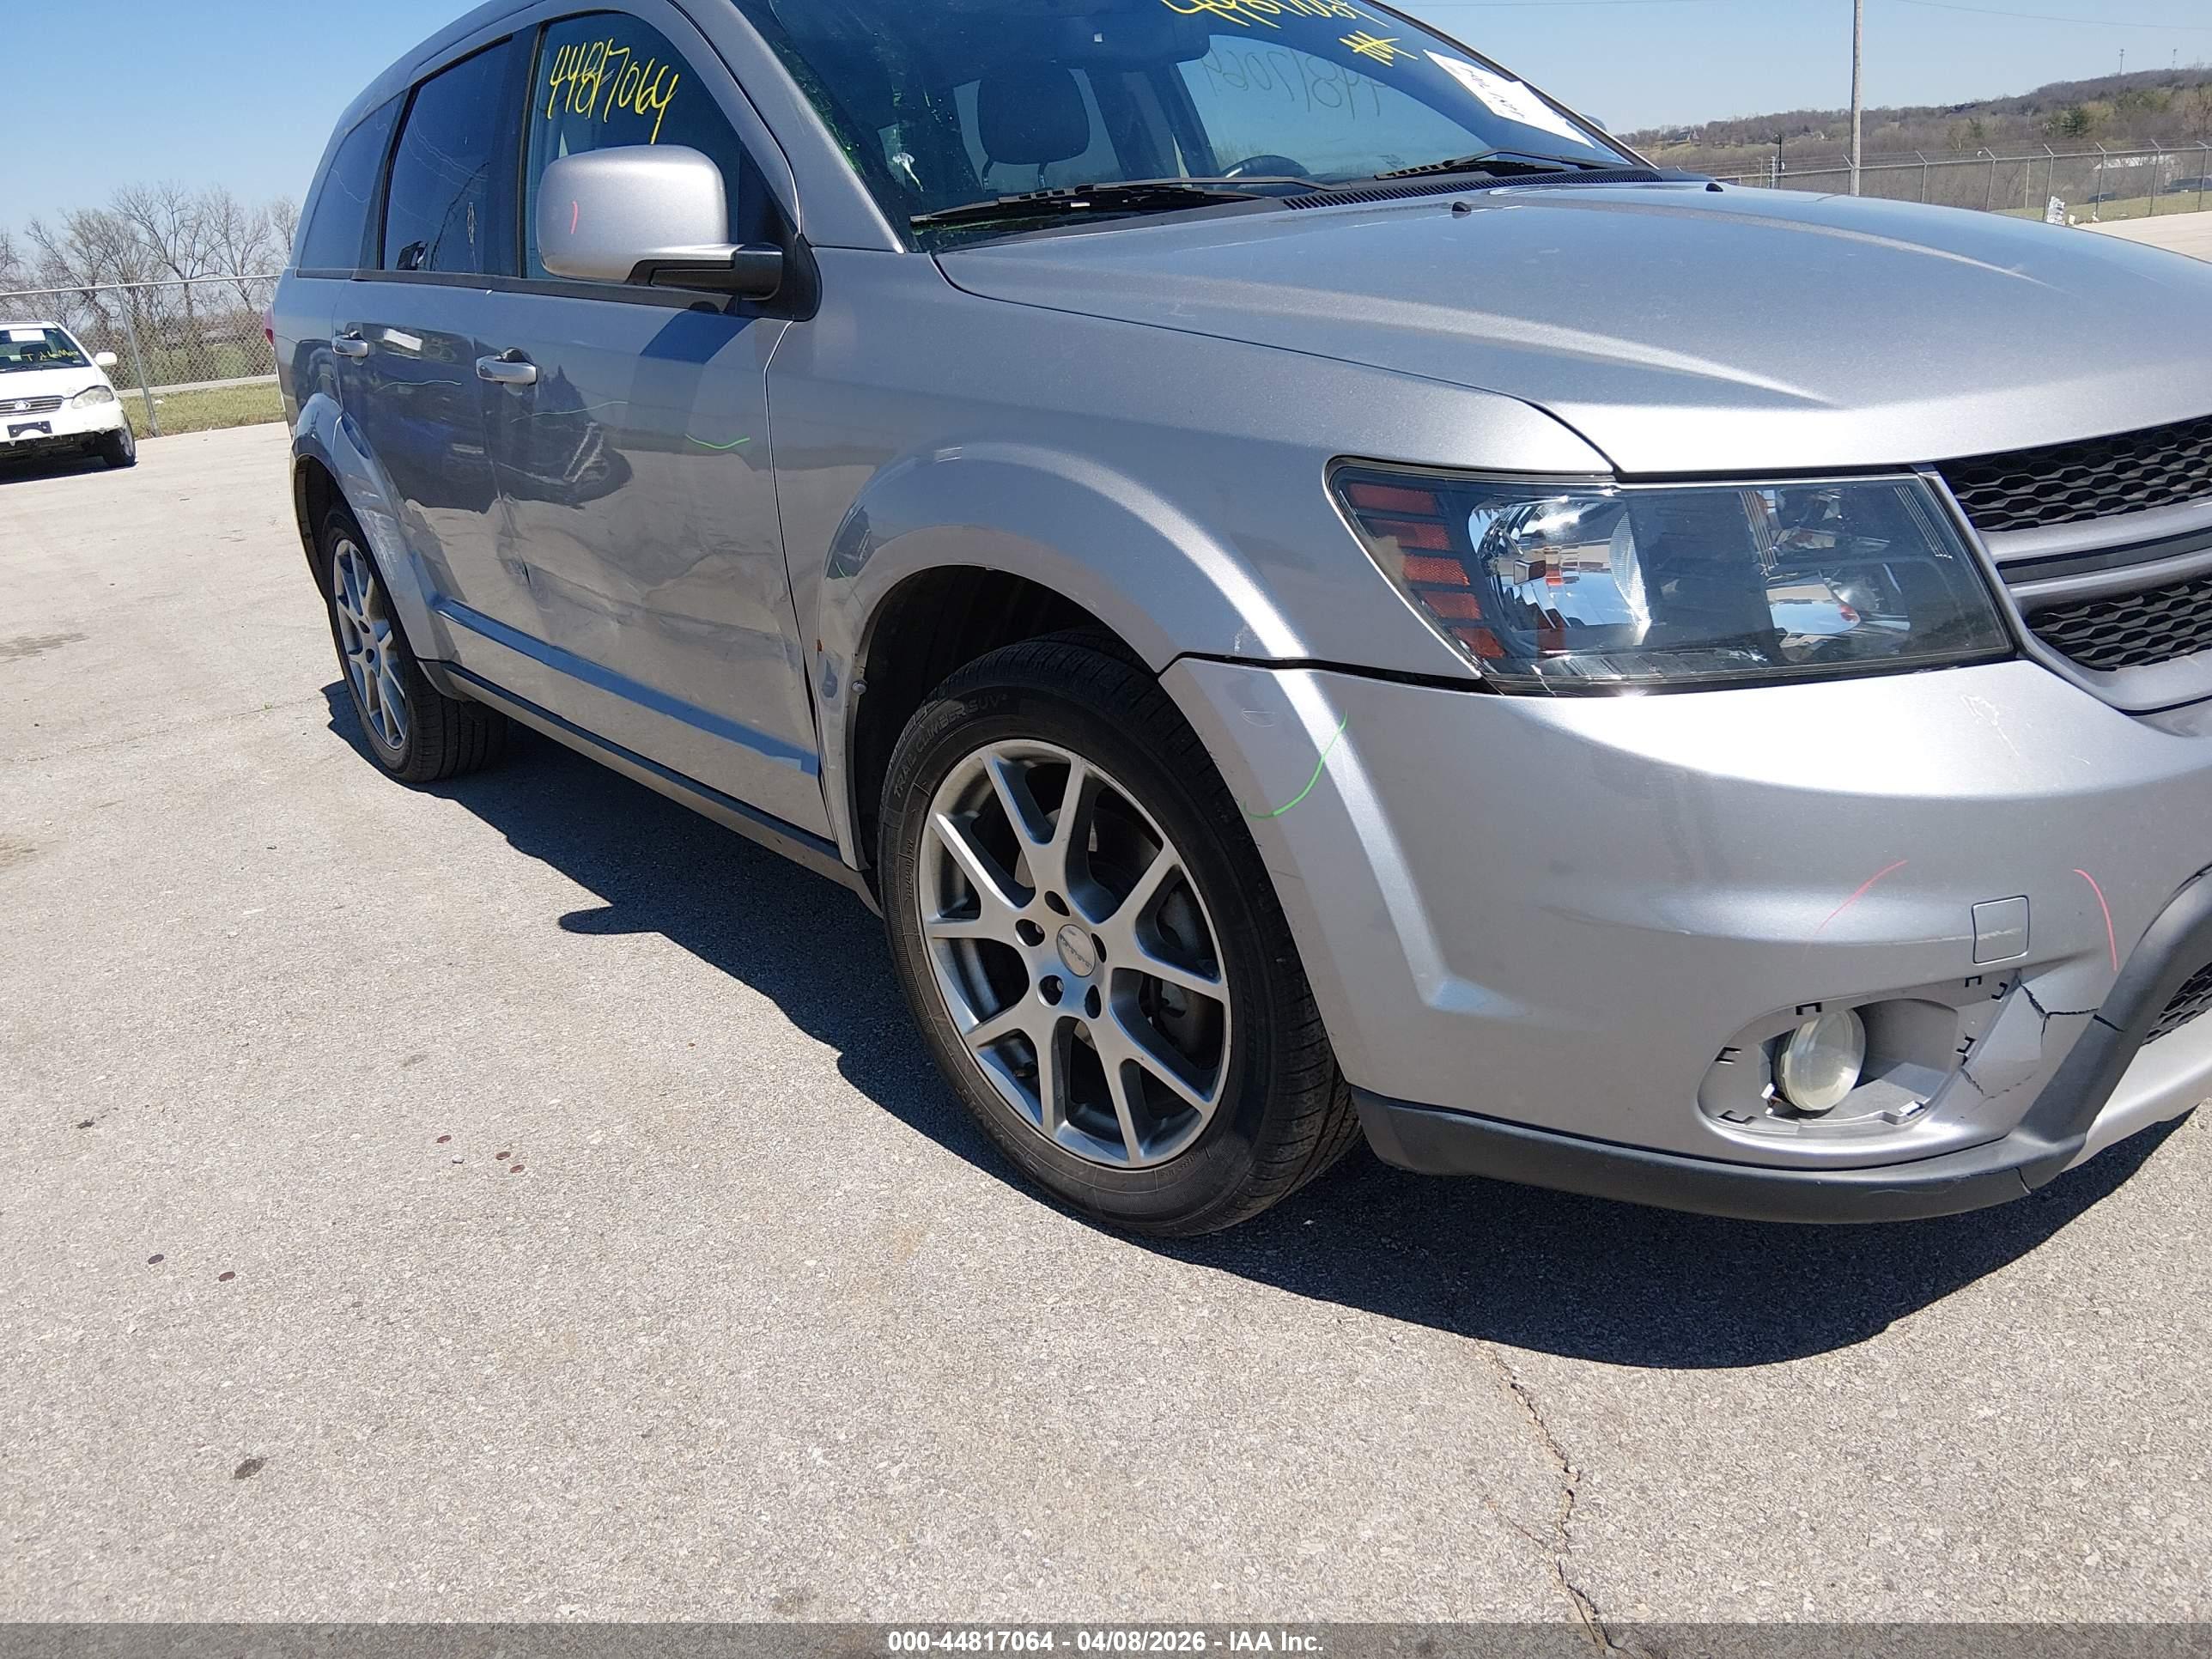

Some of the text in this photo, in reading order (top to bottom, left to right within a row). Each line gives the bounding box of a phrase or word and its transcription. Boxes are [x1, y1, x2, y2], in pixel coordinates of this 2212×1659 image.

[547, 38, 679, 145] 44817064
[894, 752, 917, 798] TRAIL
[915, 705, 967, 753] CLIMBER
